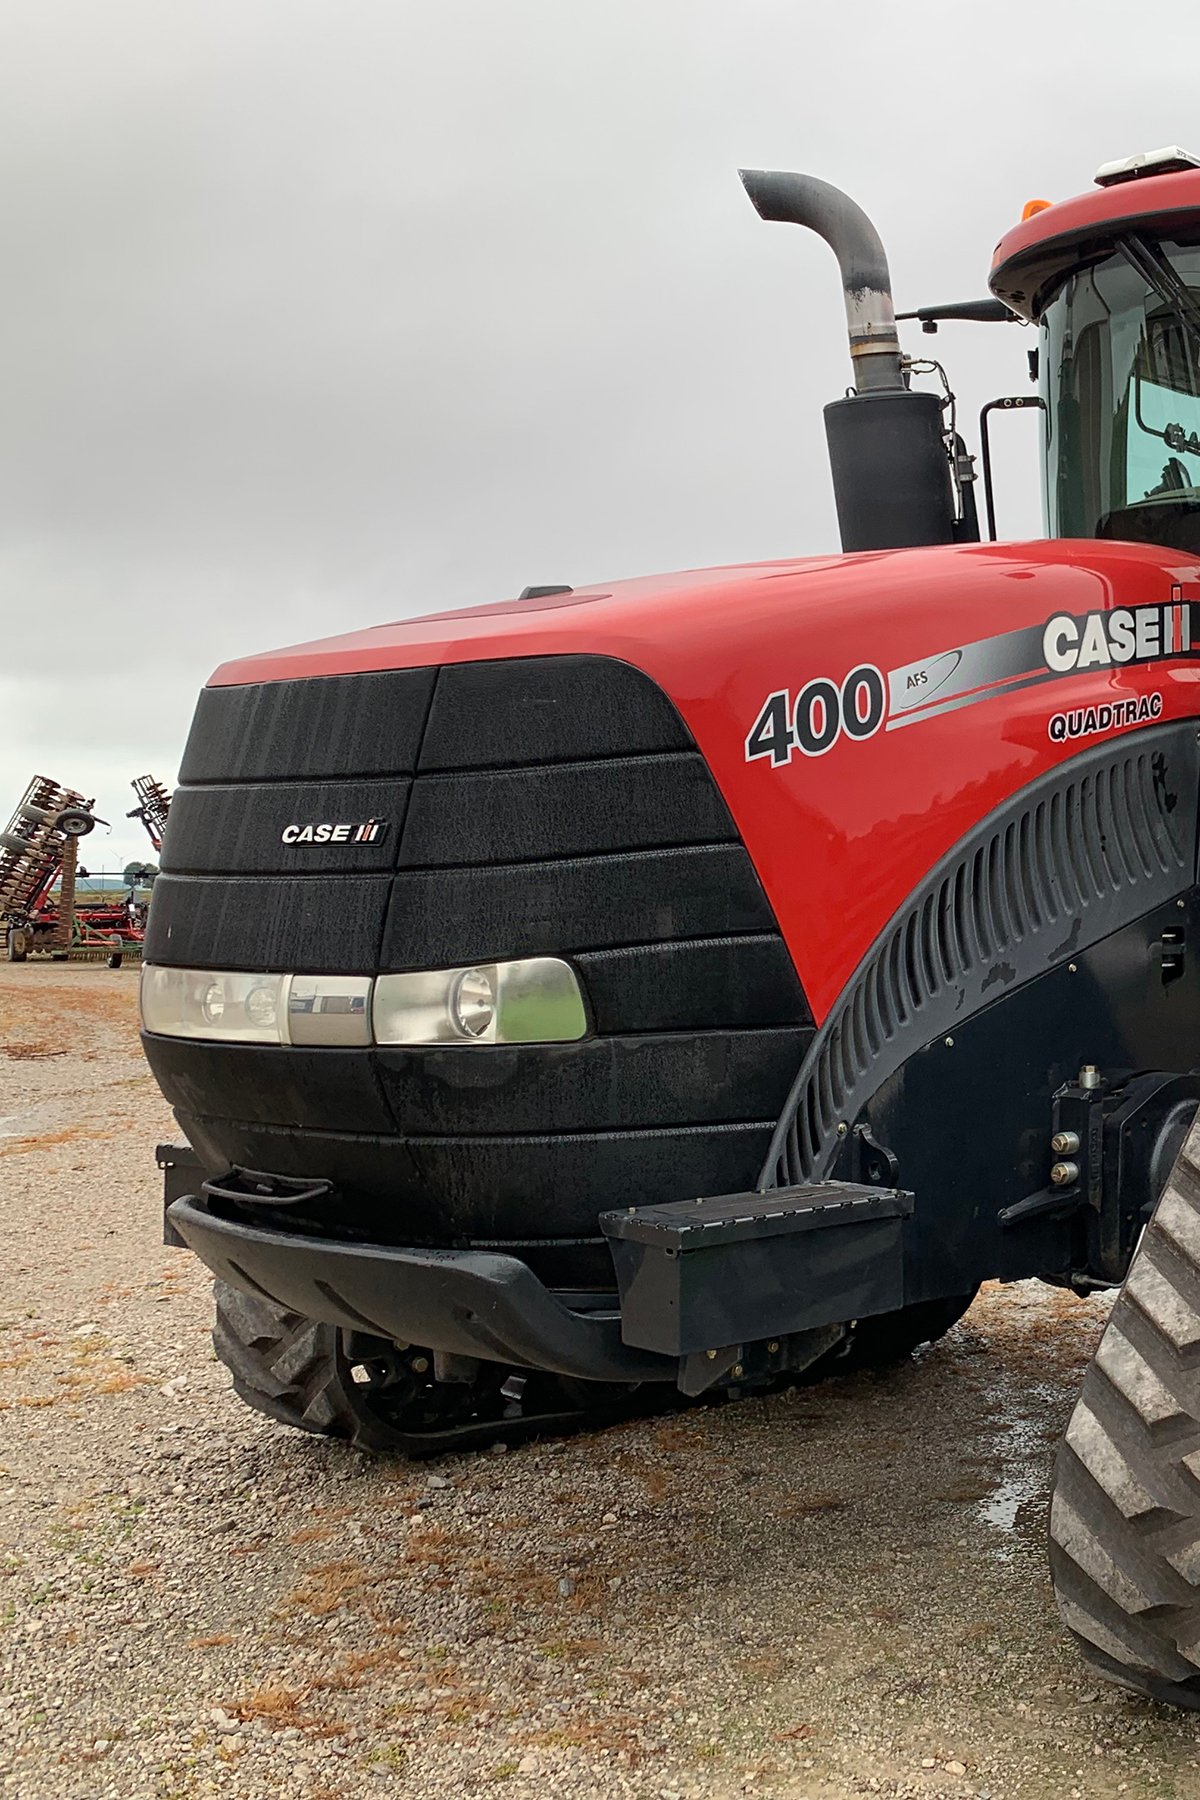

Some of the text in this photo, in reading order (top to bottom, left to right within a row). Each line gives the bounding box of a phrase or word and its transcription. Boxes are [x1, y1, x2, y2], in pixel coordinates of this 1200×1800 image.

[906, 670, 928, 689] AFS
[745, 664, 886, 768] 400
[1049, 692, 1163, 743] QUADTRAC
[281, 824, 352, 844] CASE
